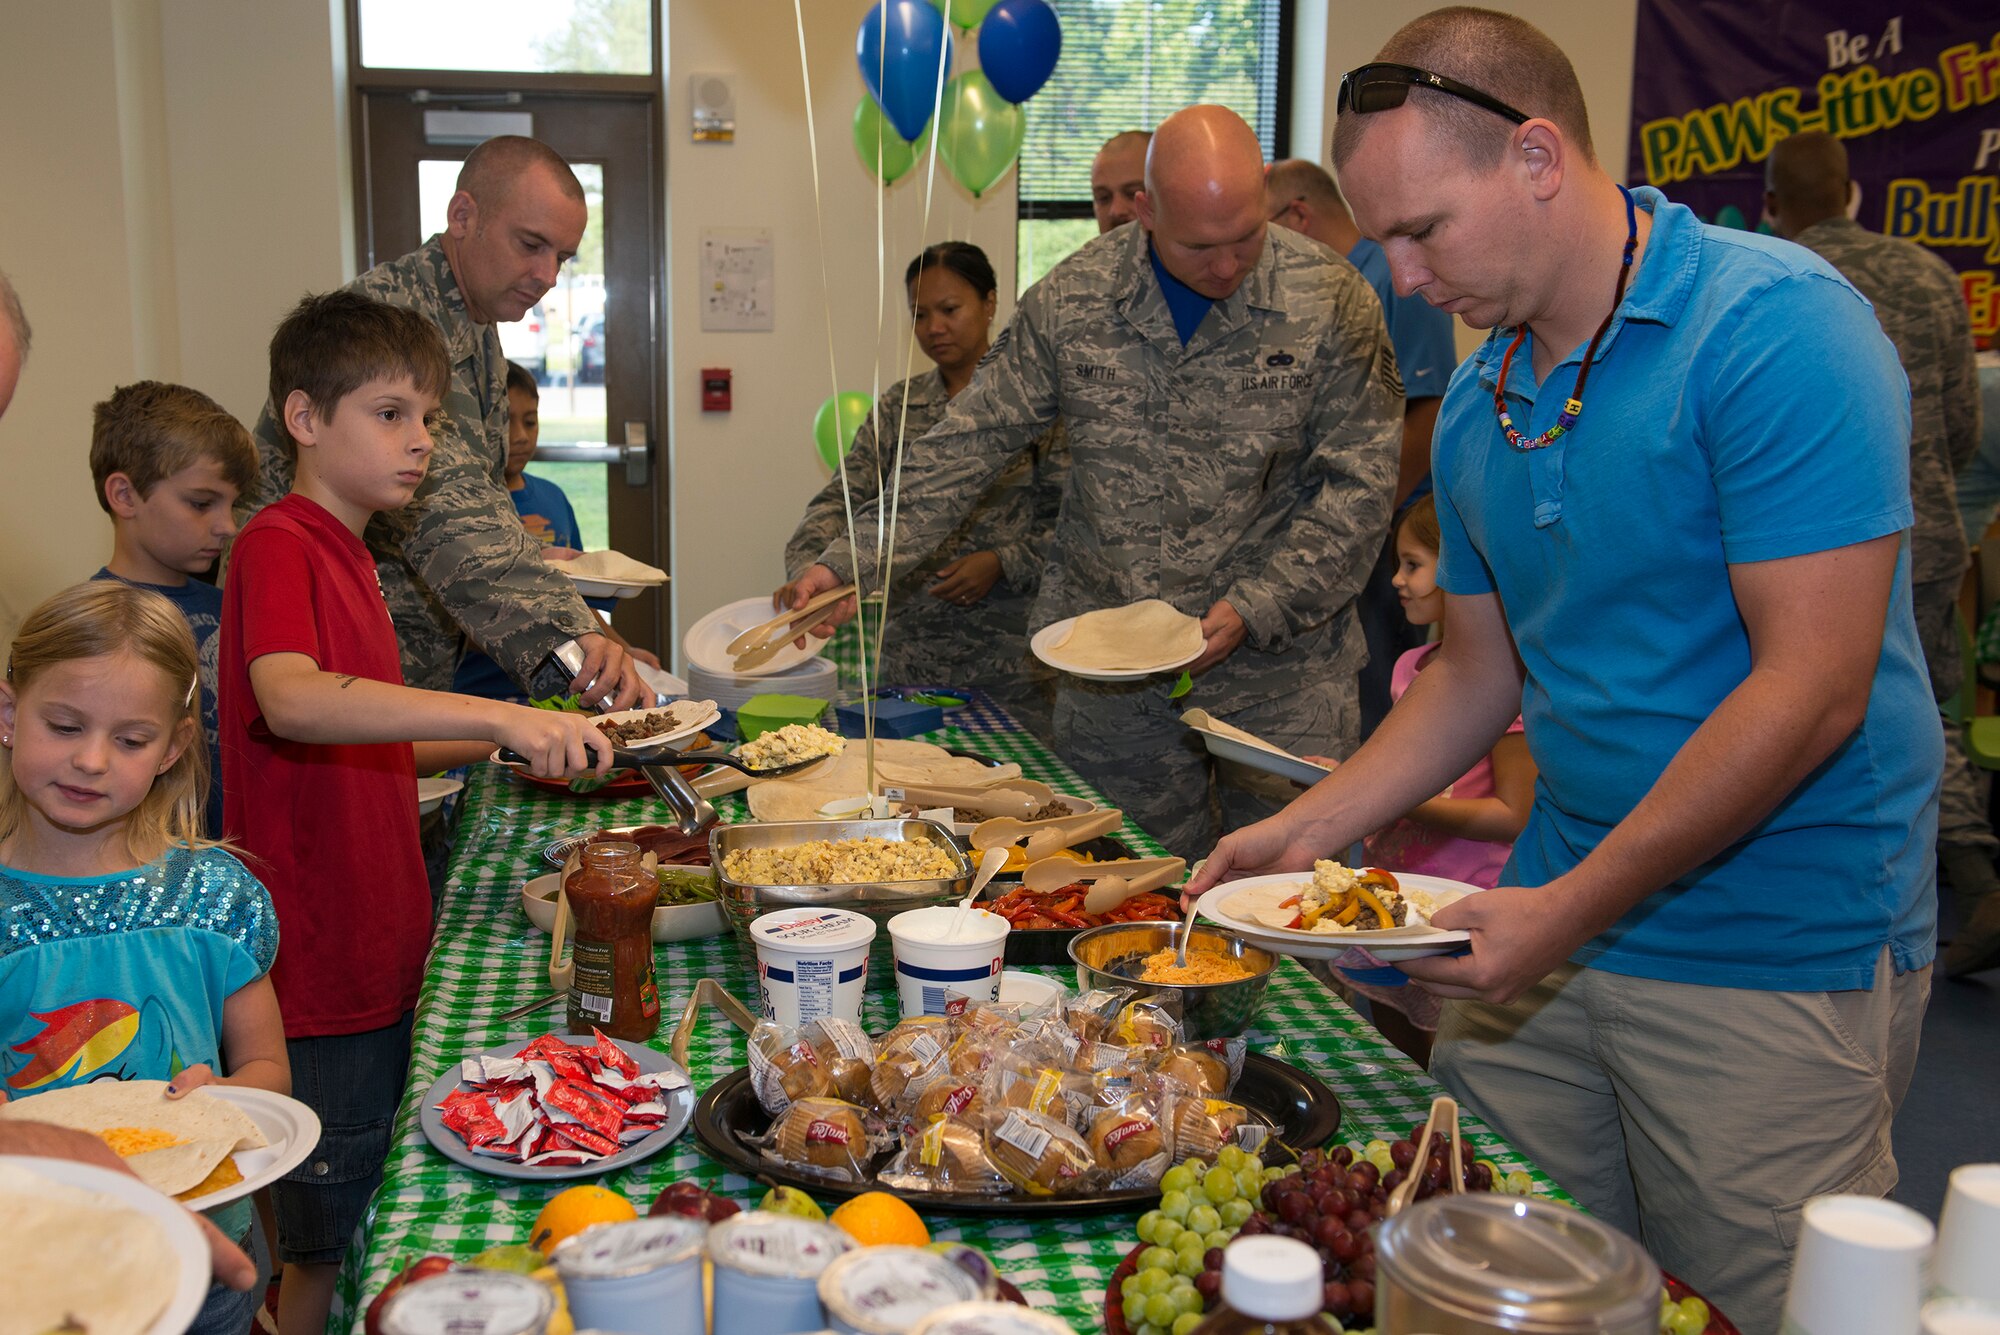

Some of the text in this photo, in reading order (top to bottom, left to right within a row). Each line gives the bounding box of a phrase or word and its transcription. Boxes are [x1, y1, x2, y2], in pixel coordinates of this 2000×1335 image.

[1825, 16, 1903, 69] Be A
[1641, 33, 2000, 186] PAWS-itive Fr
[1075, 363, 1116, 381] SMITH
[1260, 375, 1279, 389] AIR
[776, 917, 856, 939] SOUR CREAM
[779, 917, 823, 931] Daisy
